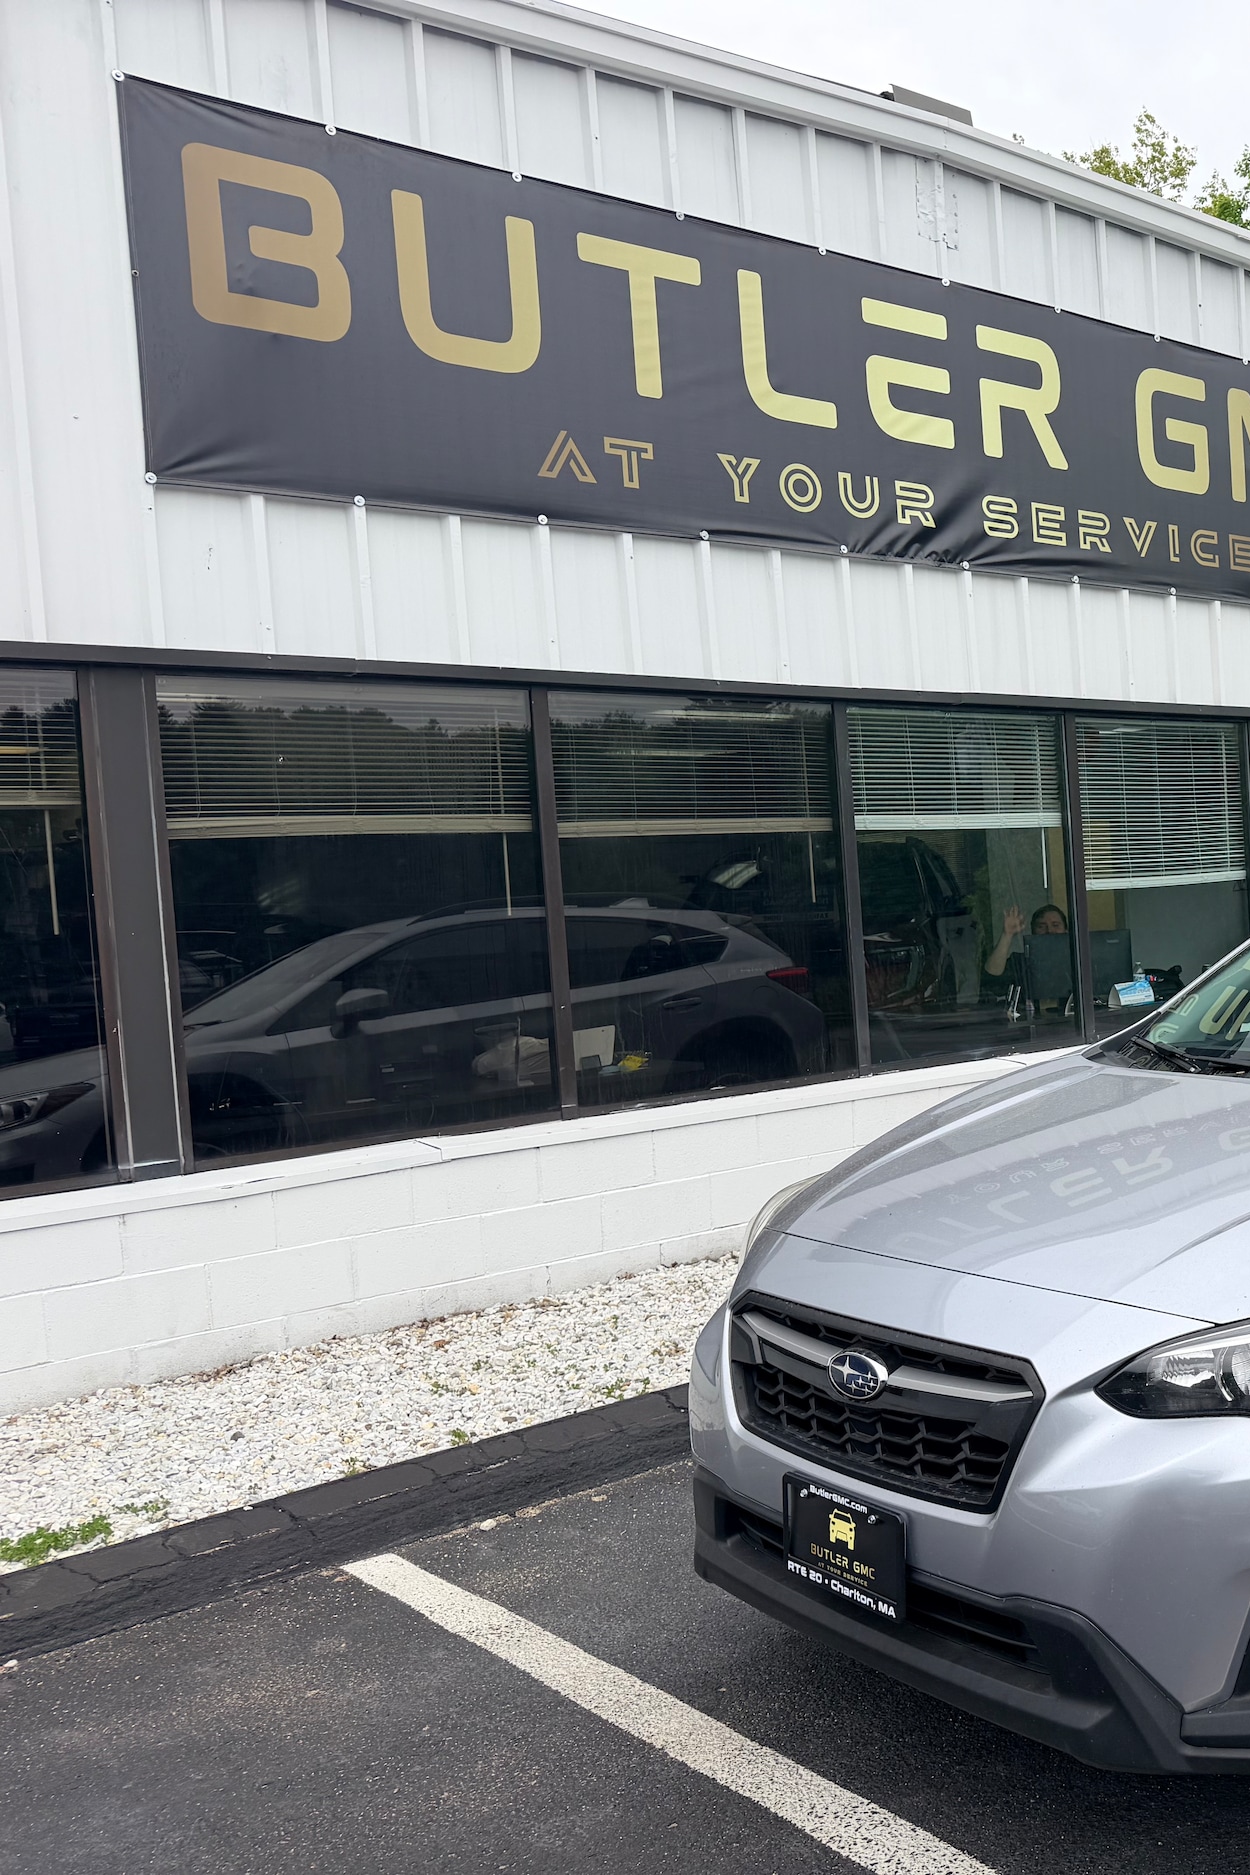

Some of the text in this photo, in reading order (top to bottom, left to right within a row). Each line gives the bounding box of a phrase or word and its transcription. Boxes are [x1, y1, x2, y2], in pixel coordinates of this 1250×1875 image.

[181, 142, 1068, 471] BUTLER
[537, 430, 654, 489] AT
[717, 452, 936, 528] YOUR
[809, 1484, 868, 1514] ButlerGMC.com
[787, 1560, 897, 1619] RTE 20 Charlton, MA
[810, 1542, 876, 1580] BUTLER GMC
